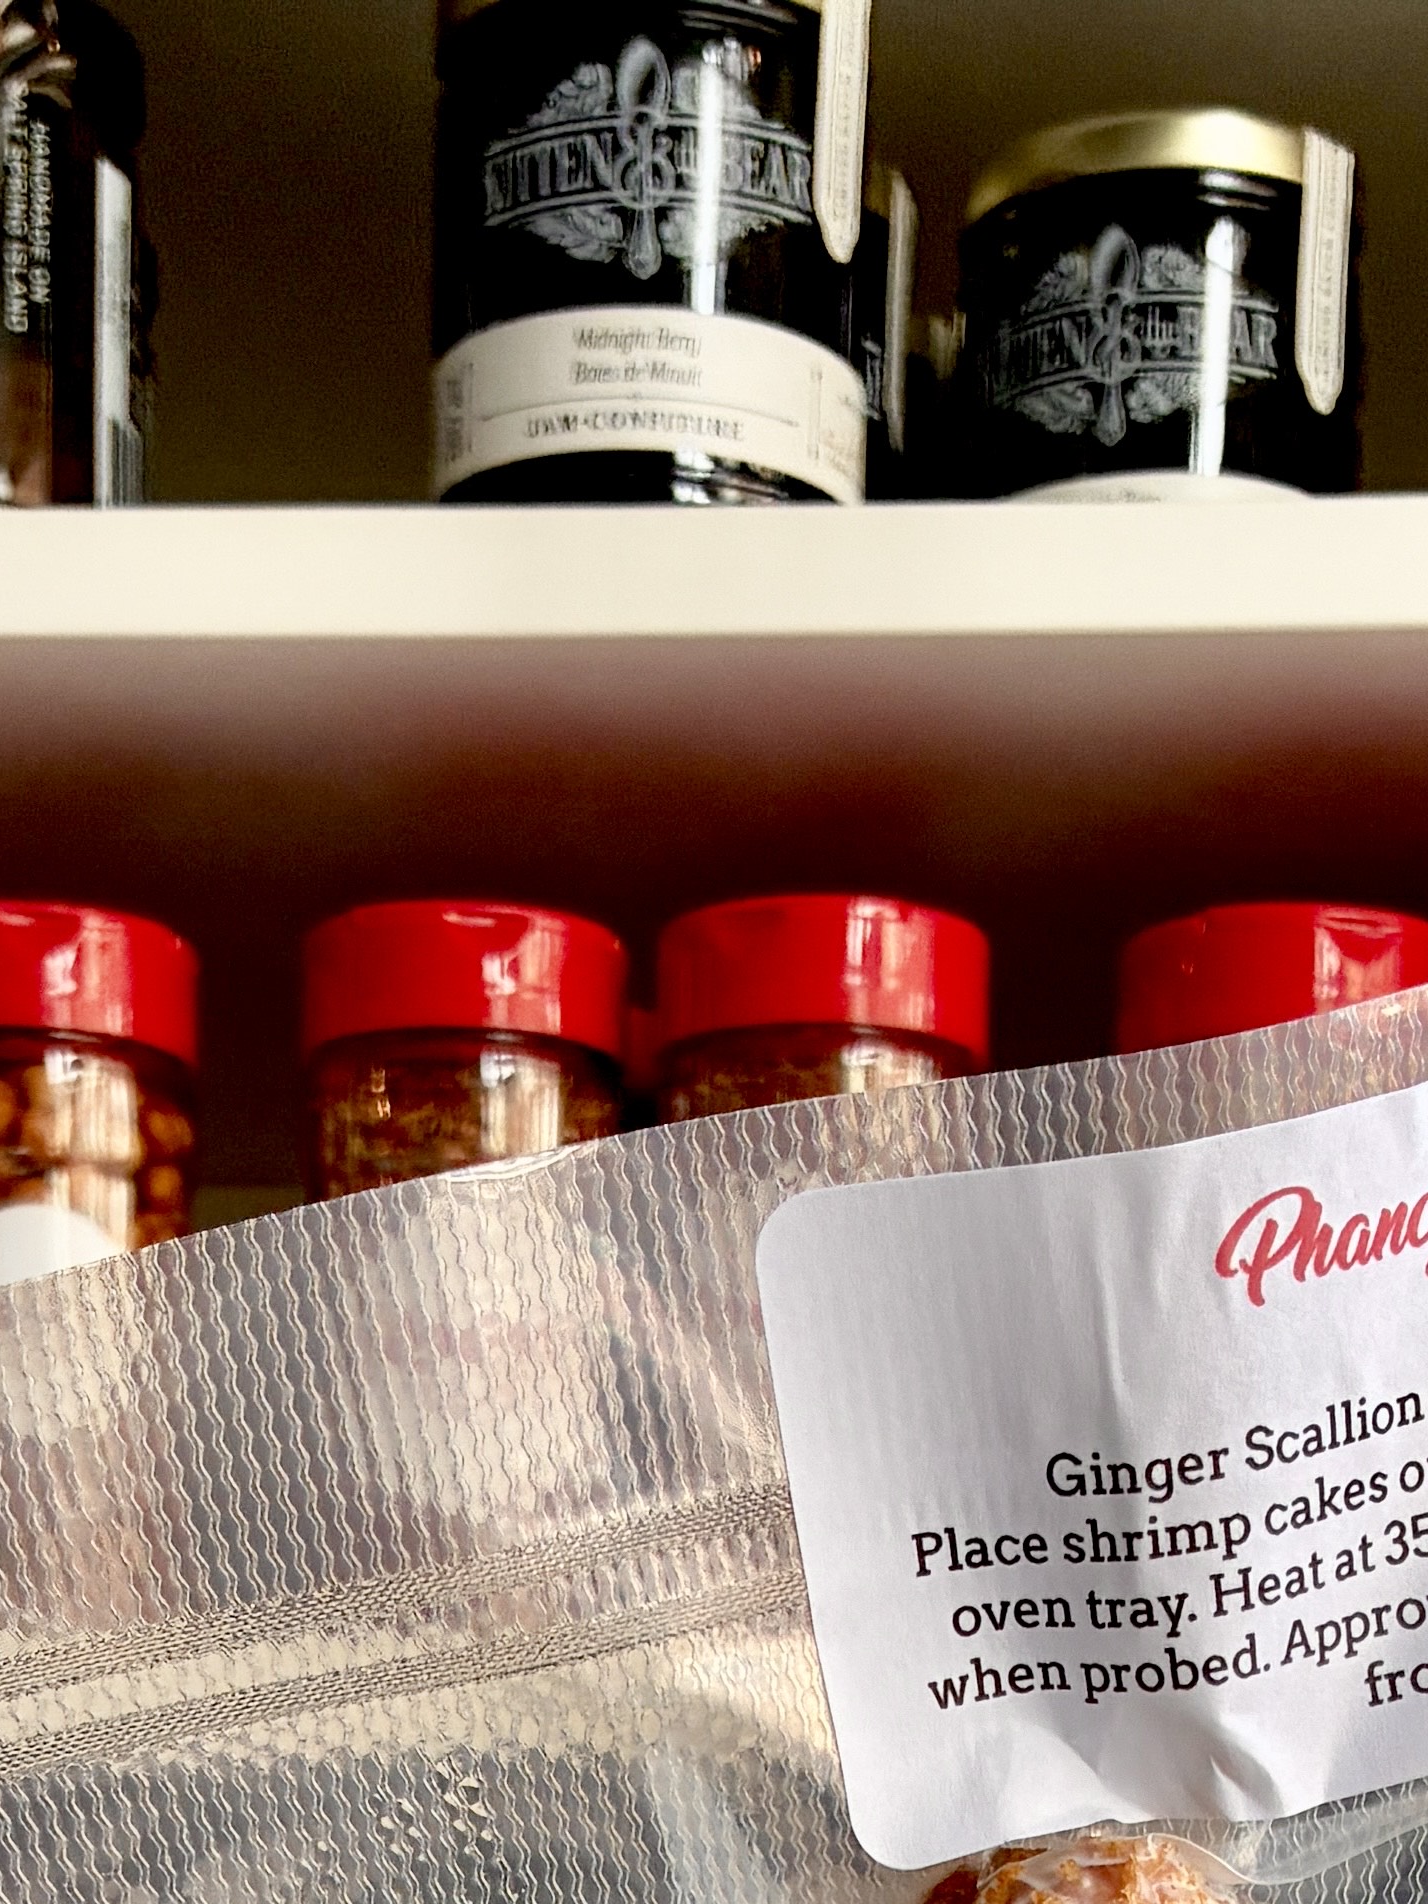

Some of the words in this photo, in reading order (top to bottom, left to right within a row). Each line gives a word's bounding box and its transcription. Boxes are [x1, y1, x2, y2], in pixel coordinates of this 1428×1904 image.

[1045, 1445, 1230, 1504] Ginger
[1244, 1391, 1425, 1472] Scallion
[911, 1527, 1049, 1578] Place
[1062, 1511, 1252, 1564] shrimp
[1264, 1469, 1389, 1537] cakes
[951, 1595, 1077, 1638] oven
[1086, 1588, 1198, 1639] tray.
[1209, 1552, 1325, 1619] Heat
[1334, 1534, 1376, 1584] at
[927, 1656, 1072, 1710] when
[1080, 1633, 1272, 1705] probed.
